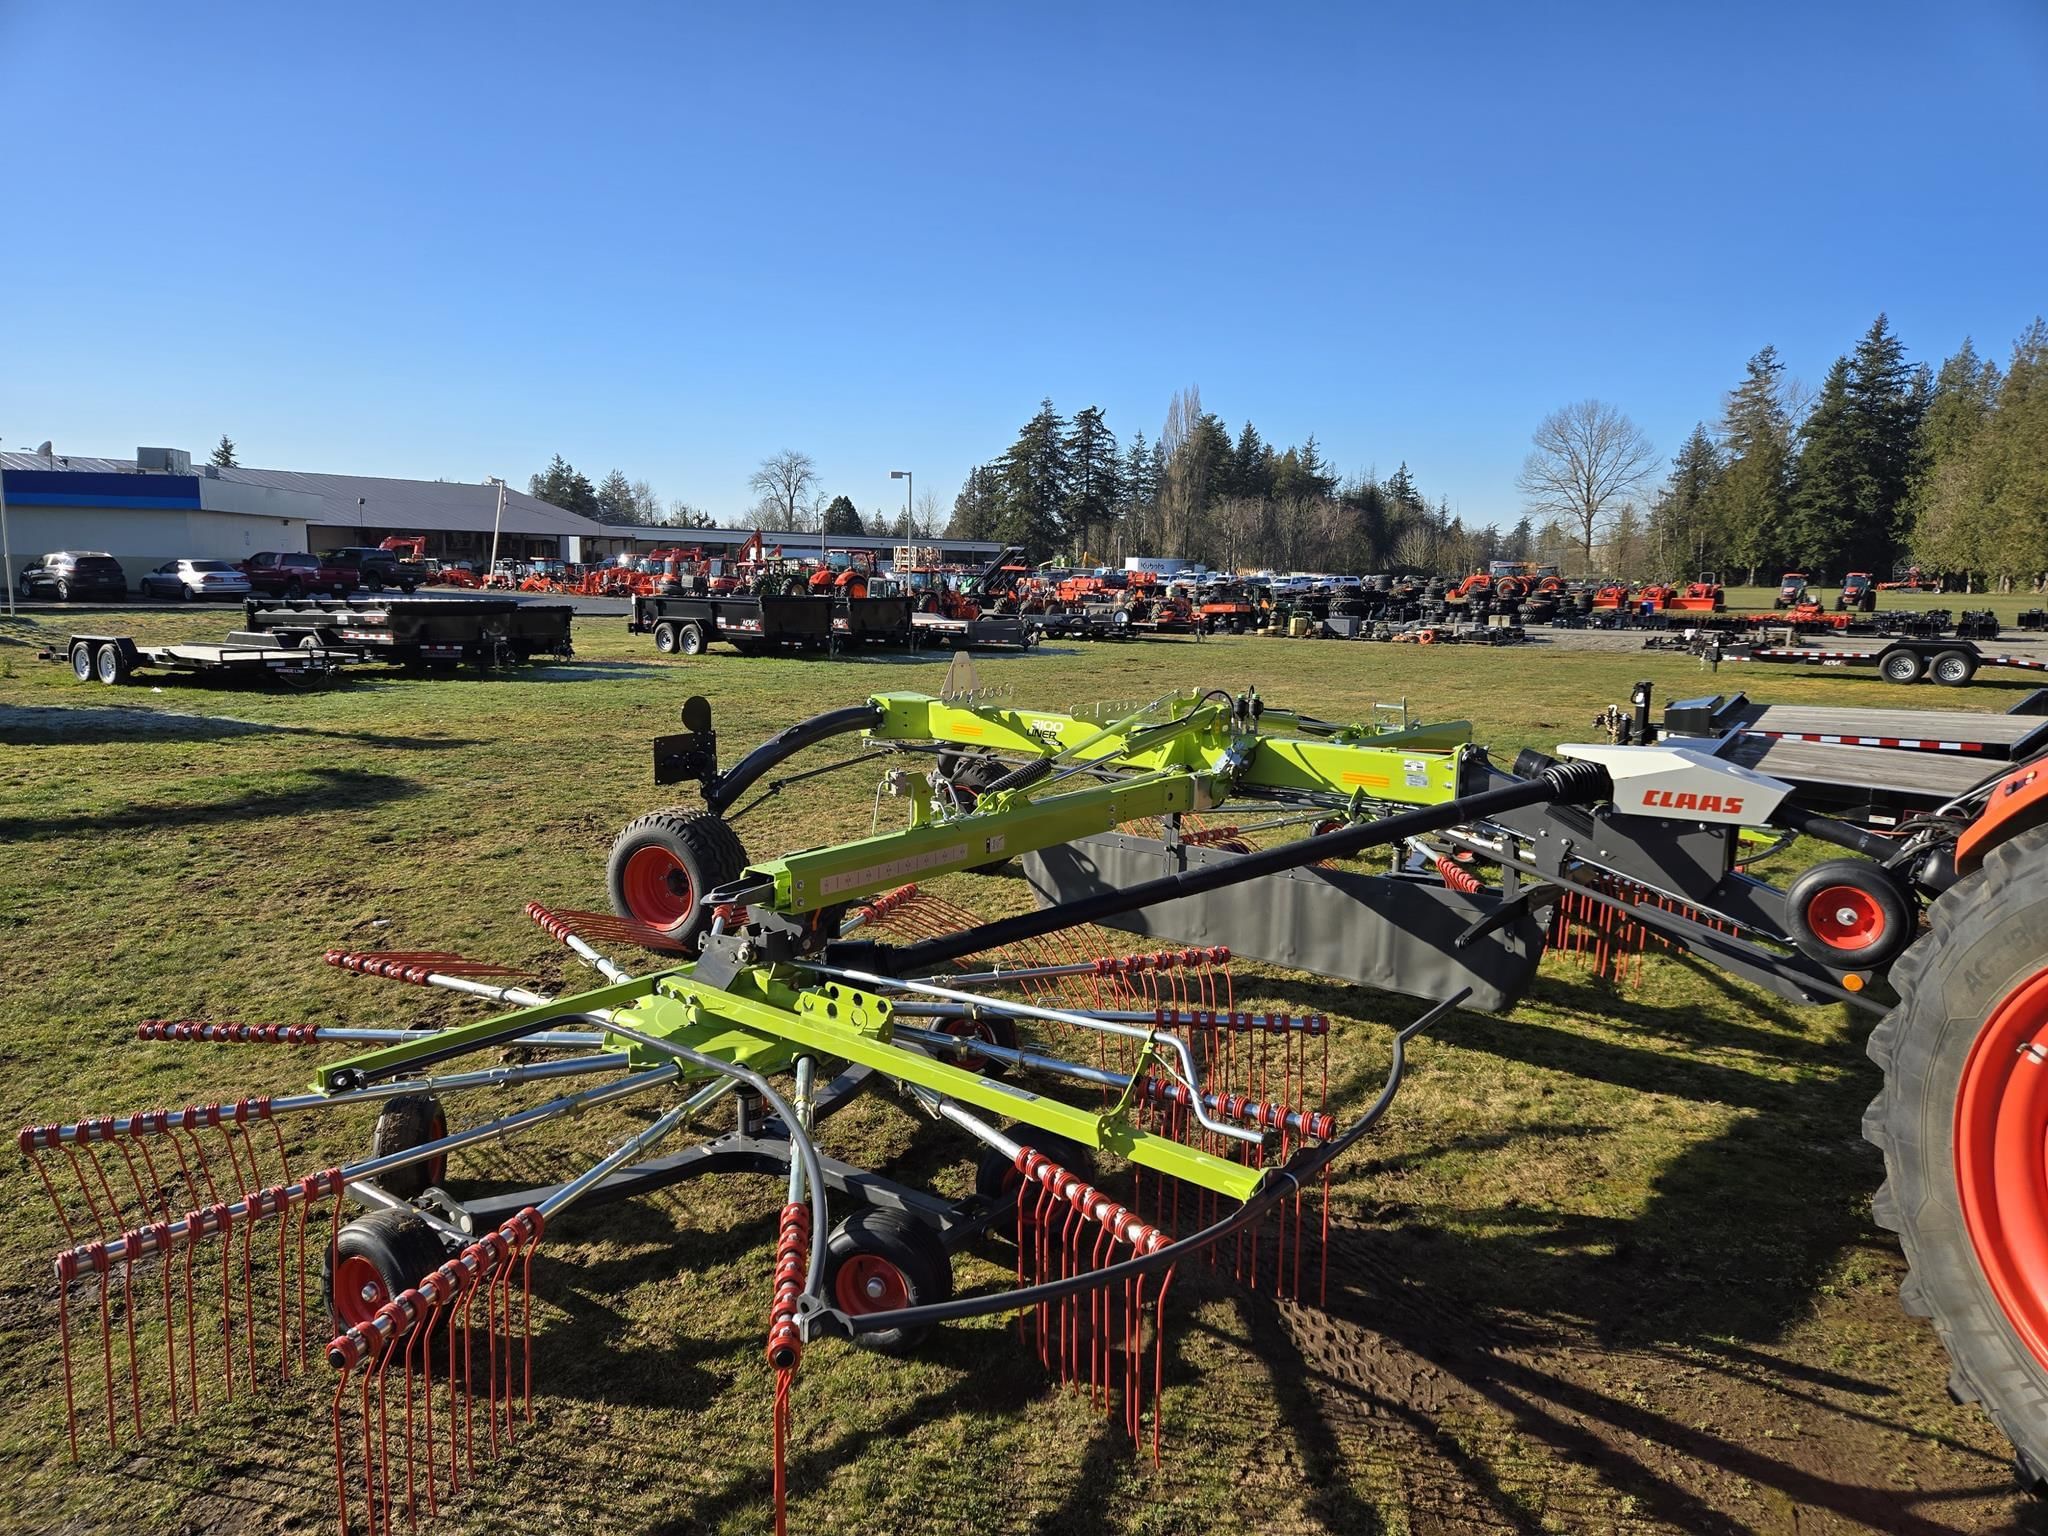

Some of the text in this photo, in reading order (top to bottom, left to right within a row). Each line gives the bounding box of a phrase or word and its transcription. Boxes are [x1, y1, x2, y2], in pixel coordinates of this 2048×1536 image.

[1140, 562, 1165, 570] Kubota
[1032, 720, 1064, 732] 3100
[1025, 728, 1057, 739] LINER
[1642, 790, 1744, 814] CLAAS
